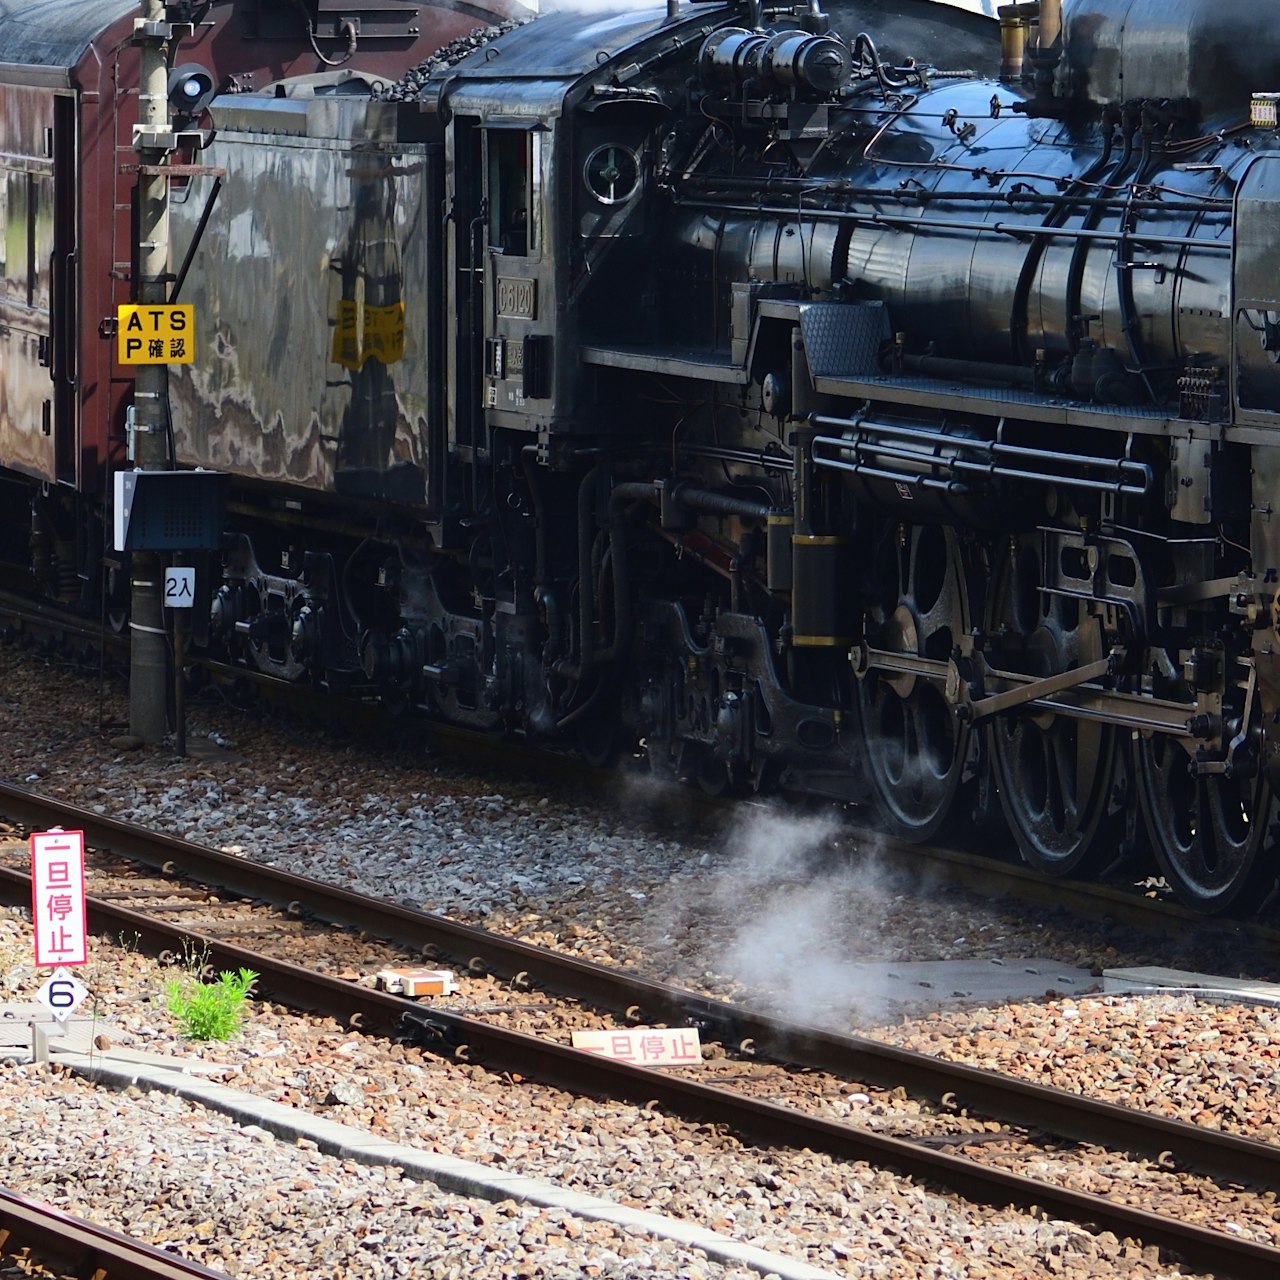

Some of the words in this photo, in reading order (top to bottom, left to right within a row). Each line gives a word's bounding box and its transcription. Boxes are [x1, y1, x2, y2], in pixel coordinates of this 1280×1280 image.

[500, 282, 531, 313] C6120
[127, 310, 186, 332] ATS
[166, 577, 192, 597] 2入
[44, 844, 74, 954] 一旦停止
[48, 980, 75, 1008] 6
[580, 1034, 697, 1062] 一旦停止
